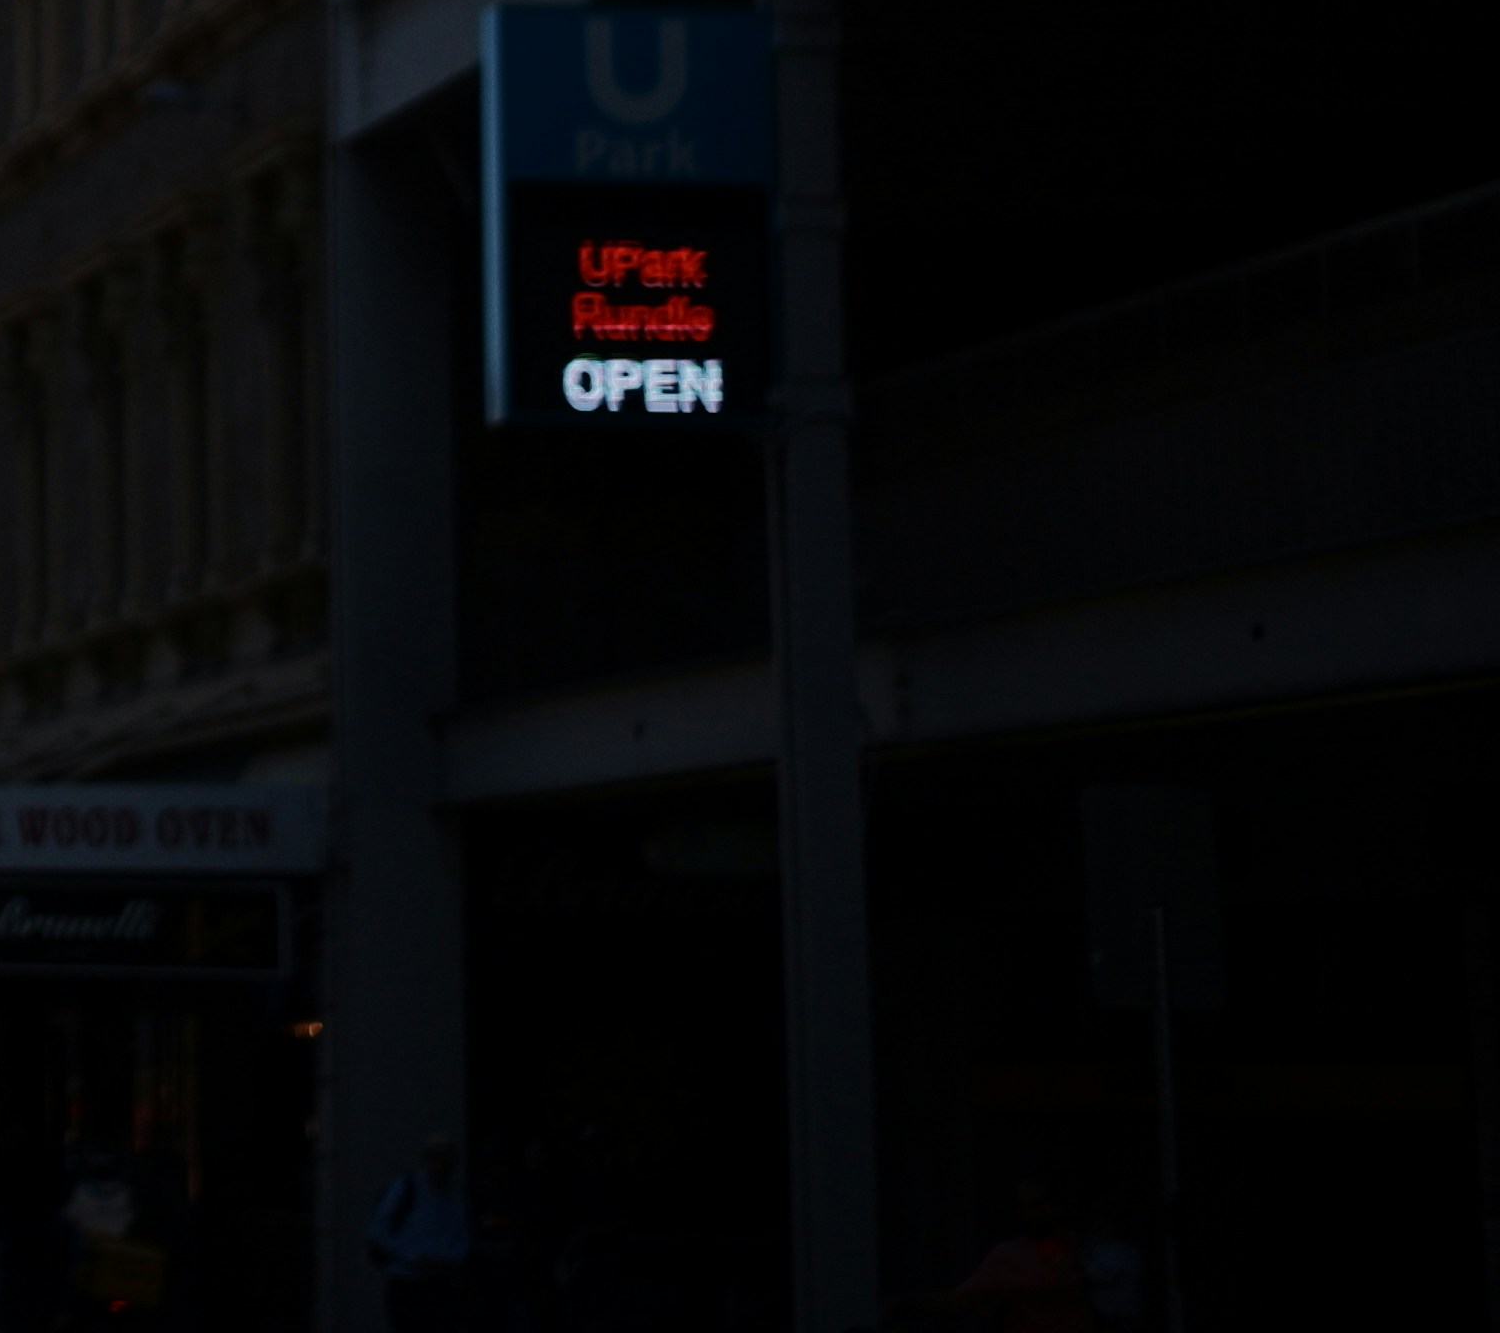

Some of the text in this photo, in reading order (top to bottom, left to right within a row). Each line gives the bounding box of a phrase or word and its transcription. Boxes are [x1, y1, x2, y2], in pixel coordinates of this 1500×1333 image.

[583, 14, 690, 125] U
[574, 128, 698, 178] Park
[574, 238, 712, 290] UPark
[569, 290, 721, 343] Rundle
[562, 355, 725, 414] OPEN
[17, 805, 140, 851] WOOD
[155, 804, 272, 850] OVEN
